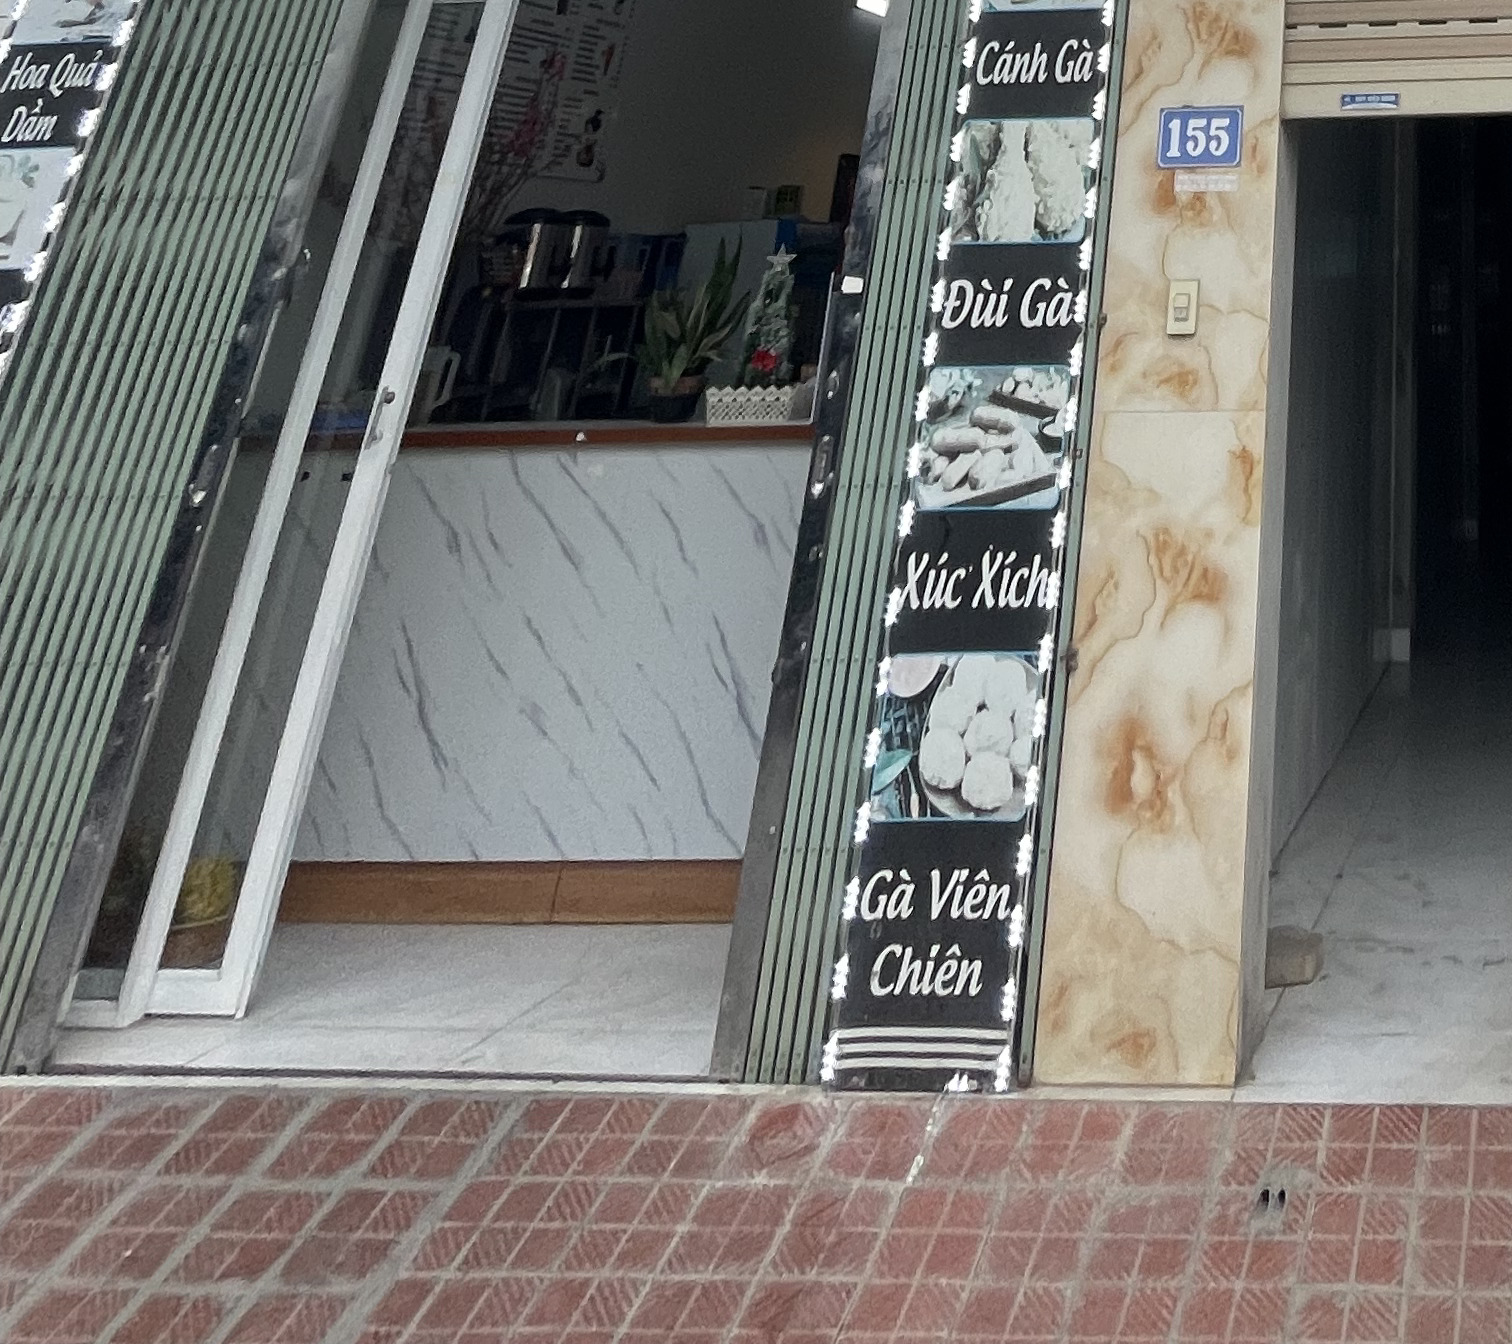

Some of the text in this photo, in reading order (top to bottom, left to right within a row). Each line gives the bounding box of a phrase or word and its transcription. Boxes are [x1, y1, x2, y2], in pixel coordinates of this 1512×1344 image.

[0, 49, 104, 99] Hoa Quả
[976, 38, 1095, 86] Cánh Gà
[1165, 117, 1230, 158] 155
[942, 275, 1076, 330] Đùi Gà
[898, 547, 1057, 610] Xúc Xích
[860, 867, 1013, 922] Gà Viên
[868, 942, 984, 998] Chiên
